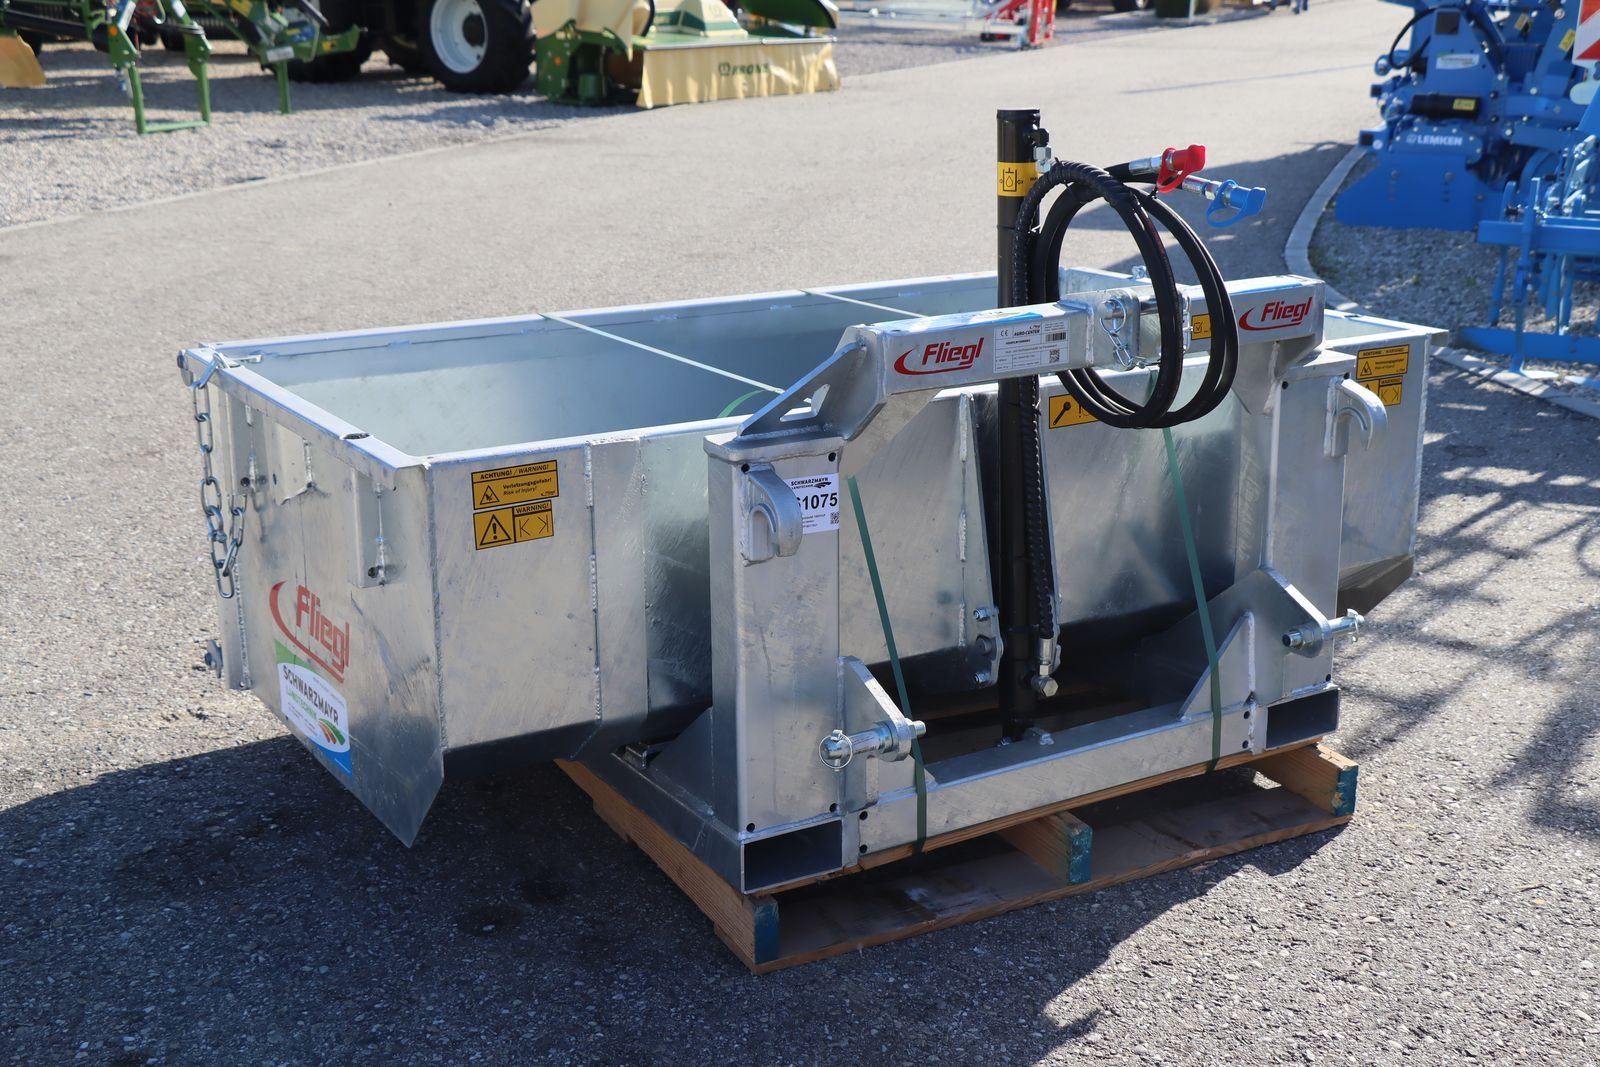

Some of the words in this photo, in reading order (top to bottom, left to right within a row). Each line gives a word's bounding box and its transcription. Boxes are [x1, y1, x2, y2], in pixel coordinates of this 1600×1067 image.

[1417, 134, 1463, 146] LEMKEN
[1260, 297, 1313, 322] Fliegl
[921, 337, 985, 365] Fliegl
[480, 470, 513, 480] ACHTUNG!
[518, 464, 550, 474] WARNING!
[791, 477, 829, 486] SCHWARZMAYR
[515, 503, 549, 513] WARNING!
[296, 584, 350, 674] Fliegl
[283, 665, 339, 724] SCHWARZMAYR
